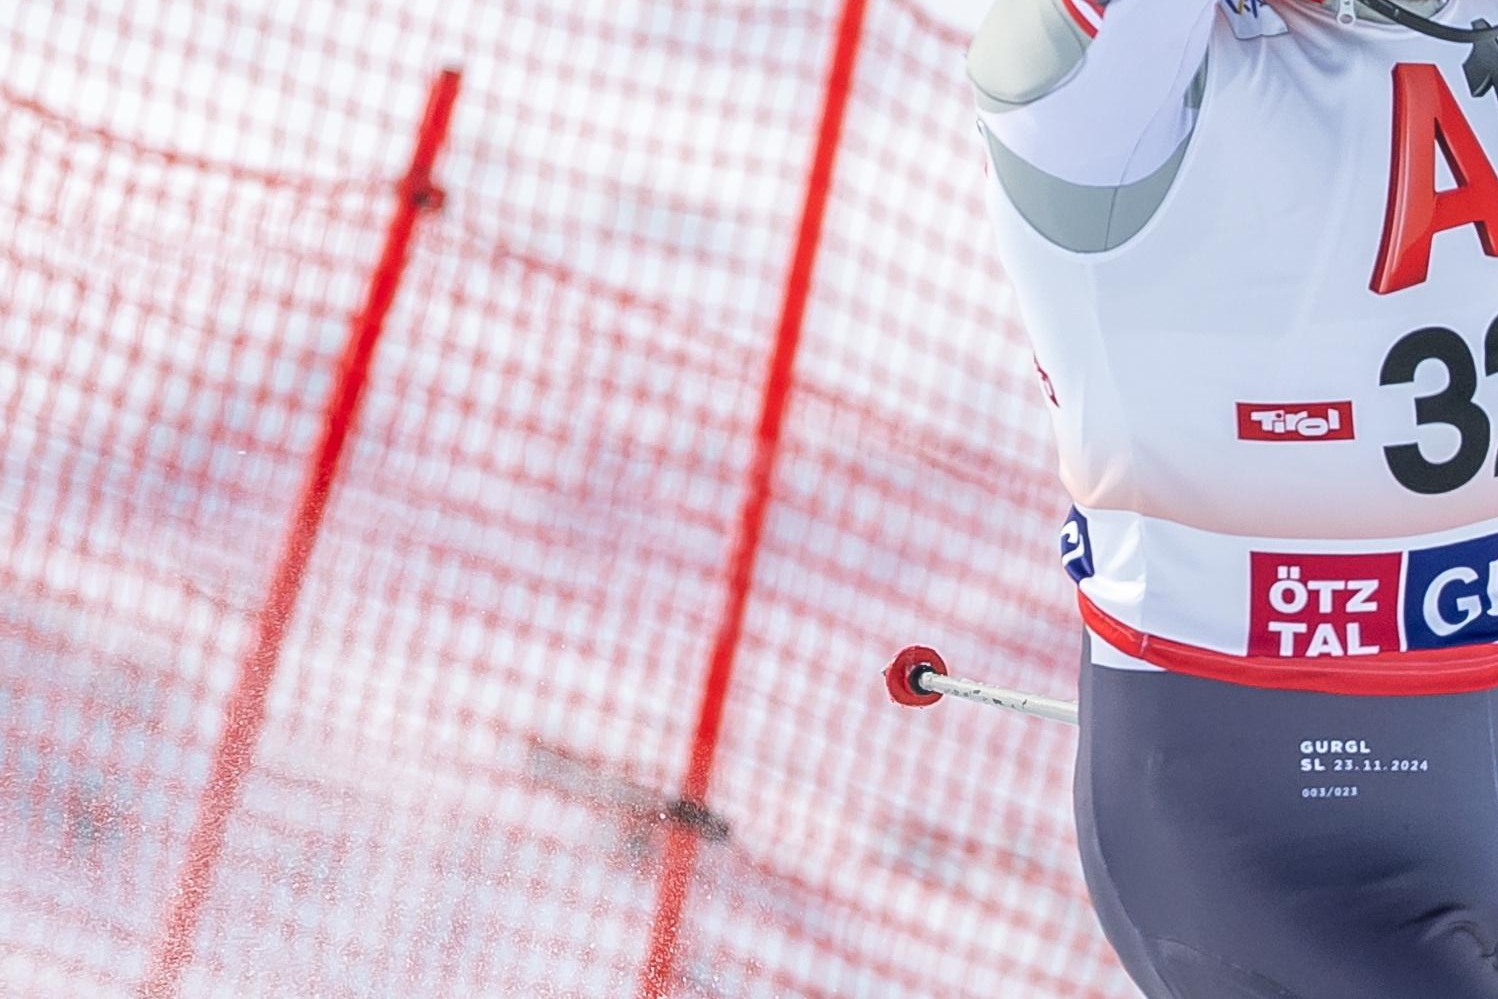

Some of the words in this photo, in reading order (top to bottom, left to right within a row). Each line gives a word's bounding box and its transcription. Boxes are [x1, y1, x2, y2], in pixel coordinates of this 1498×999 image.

[1251, 409, 1340, 436] Tirol
[1268, 565, 1379, 614] ÖTZ
[1268, 622, 1380, 657] TAL
[1300, 740, 1371, 754] GURGL
[1300, 758, 1326, 771] SL
[1334, 760, 1428, 771] 23.11.2024
